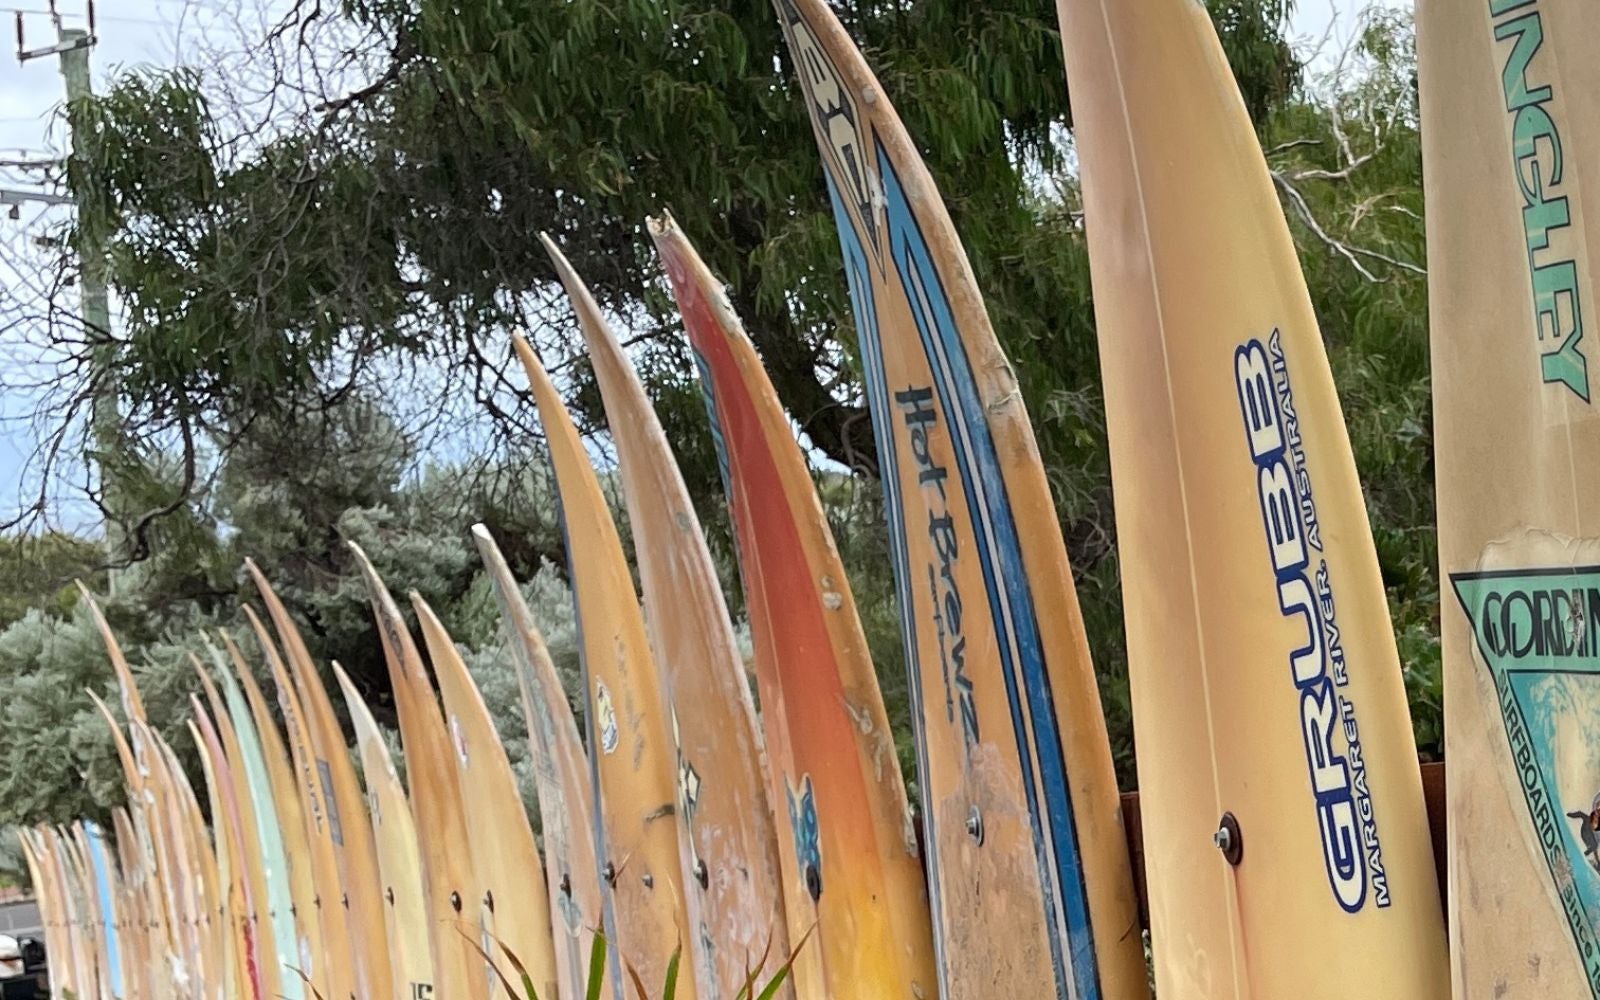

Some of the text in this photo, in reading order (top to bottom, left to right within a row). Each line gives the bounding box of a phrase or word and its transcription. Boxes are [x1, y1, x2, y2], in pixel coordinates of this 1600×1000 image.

[895, 384, 947, 501] Hot
[1268, 328, 1320, 552] AUSTRALIA
[1234, 338, 1367, 913] GRUBB
[1342, 698, 1391, 907] MARGARET
[1500, 668, 1563, 868] SURFBOARDS
